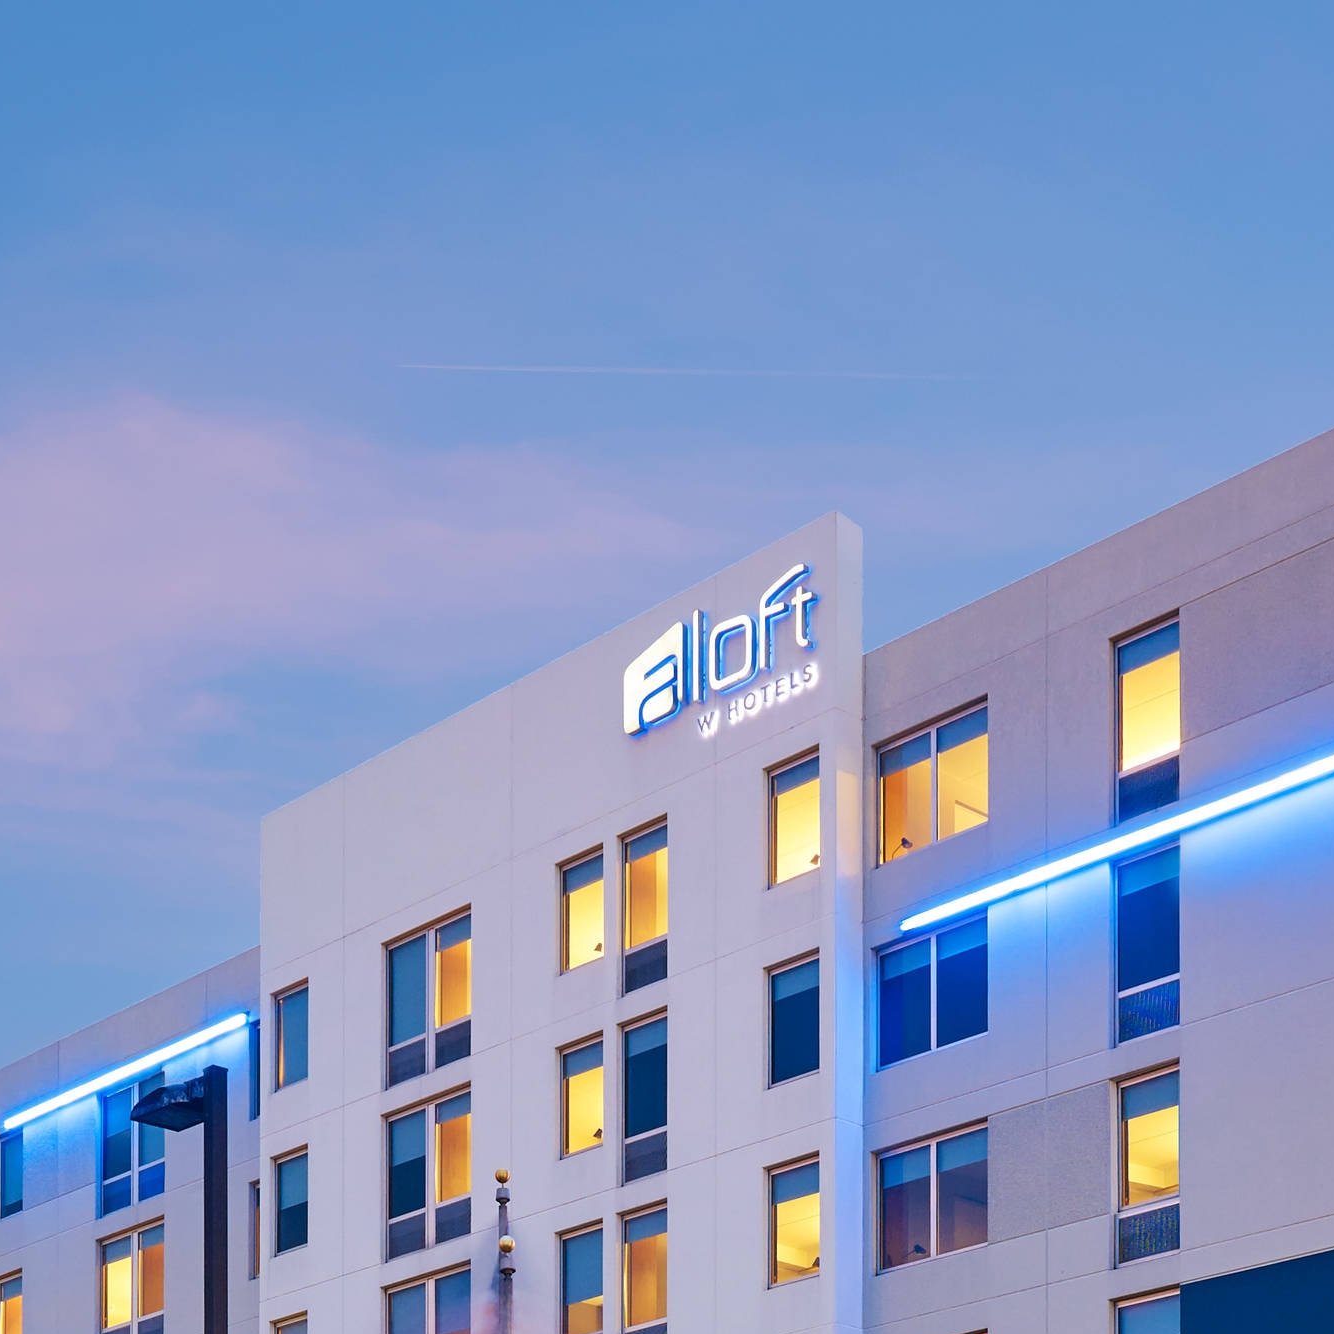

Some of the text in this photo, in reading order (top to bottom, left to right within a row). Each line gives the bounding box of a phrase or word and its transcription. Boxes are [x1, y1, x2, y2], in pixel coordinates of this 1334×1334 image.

[623, 562, 816, 736] aloft
[697, 664, 814, 733] W HOTELS
